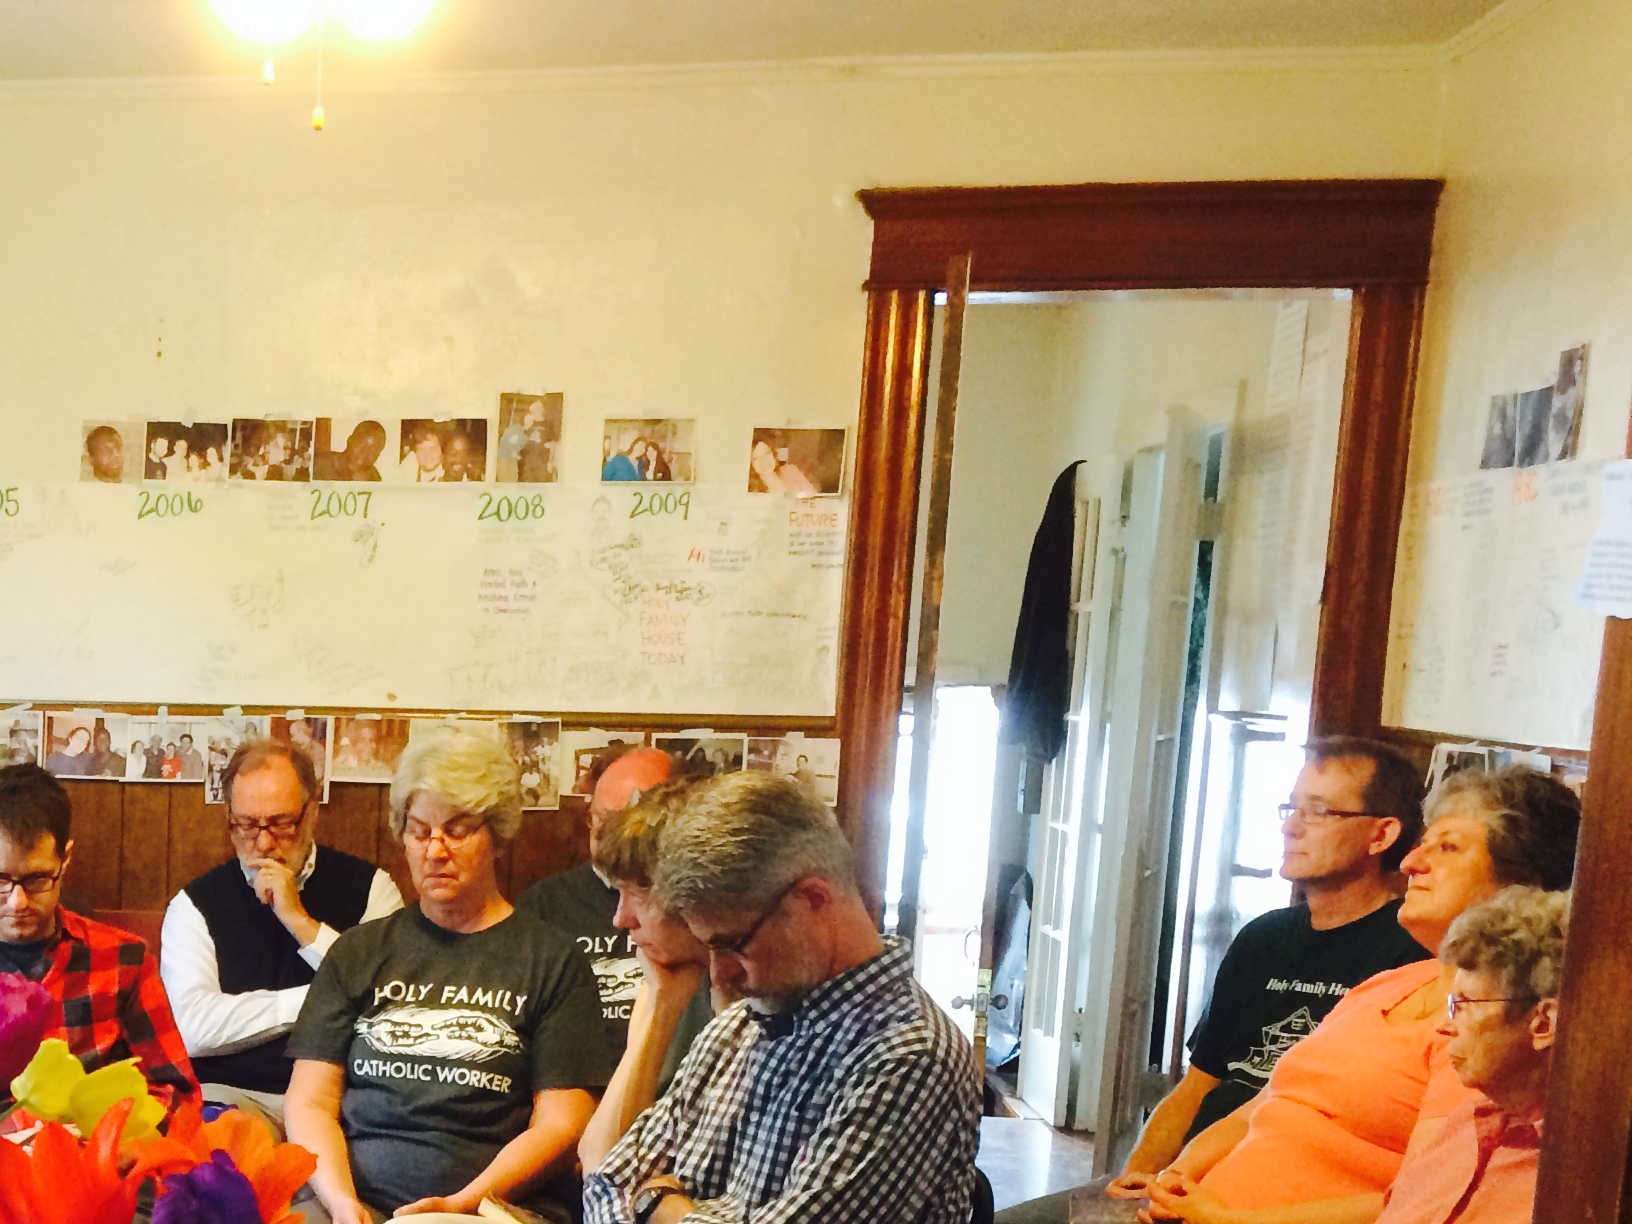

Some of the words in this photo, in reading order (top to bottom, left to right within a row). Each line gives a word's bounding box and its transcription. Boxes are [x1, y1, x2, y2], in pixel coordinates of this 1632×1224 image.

[137, 490, 204, 520] 2006
[310, 488, 373, 520] 2007
[477, 491, 545, 522] 2008
[629, 491, 690, 520] 2009
[789, 511, 838, 528] FUTURE
[639, 613, 690, 628] FAMILY
[641, 631, 686, 646] HOUSE
[639, 651, 686, 666] TODAY
[576, 935, 618, 954] OLY
[374, 980, 434, 1006] HOLY
[440, 983, 528, 1016] FAMILY
[1266, 978, 1289, 994] Holy
[1289, 980, 1329, 998] Family
[353, 1058, 433, 1082] CATHOLIC
[436, 1065, 513, 1094] WORKER
